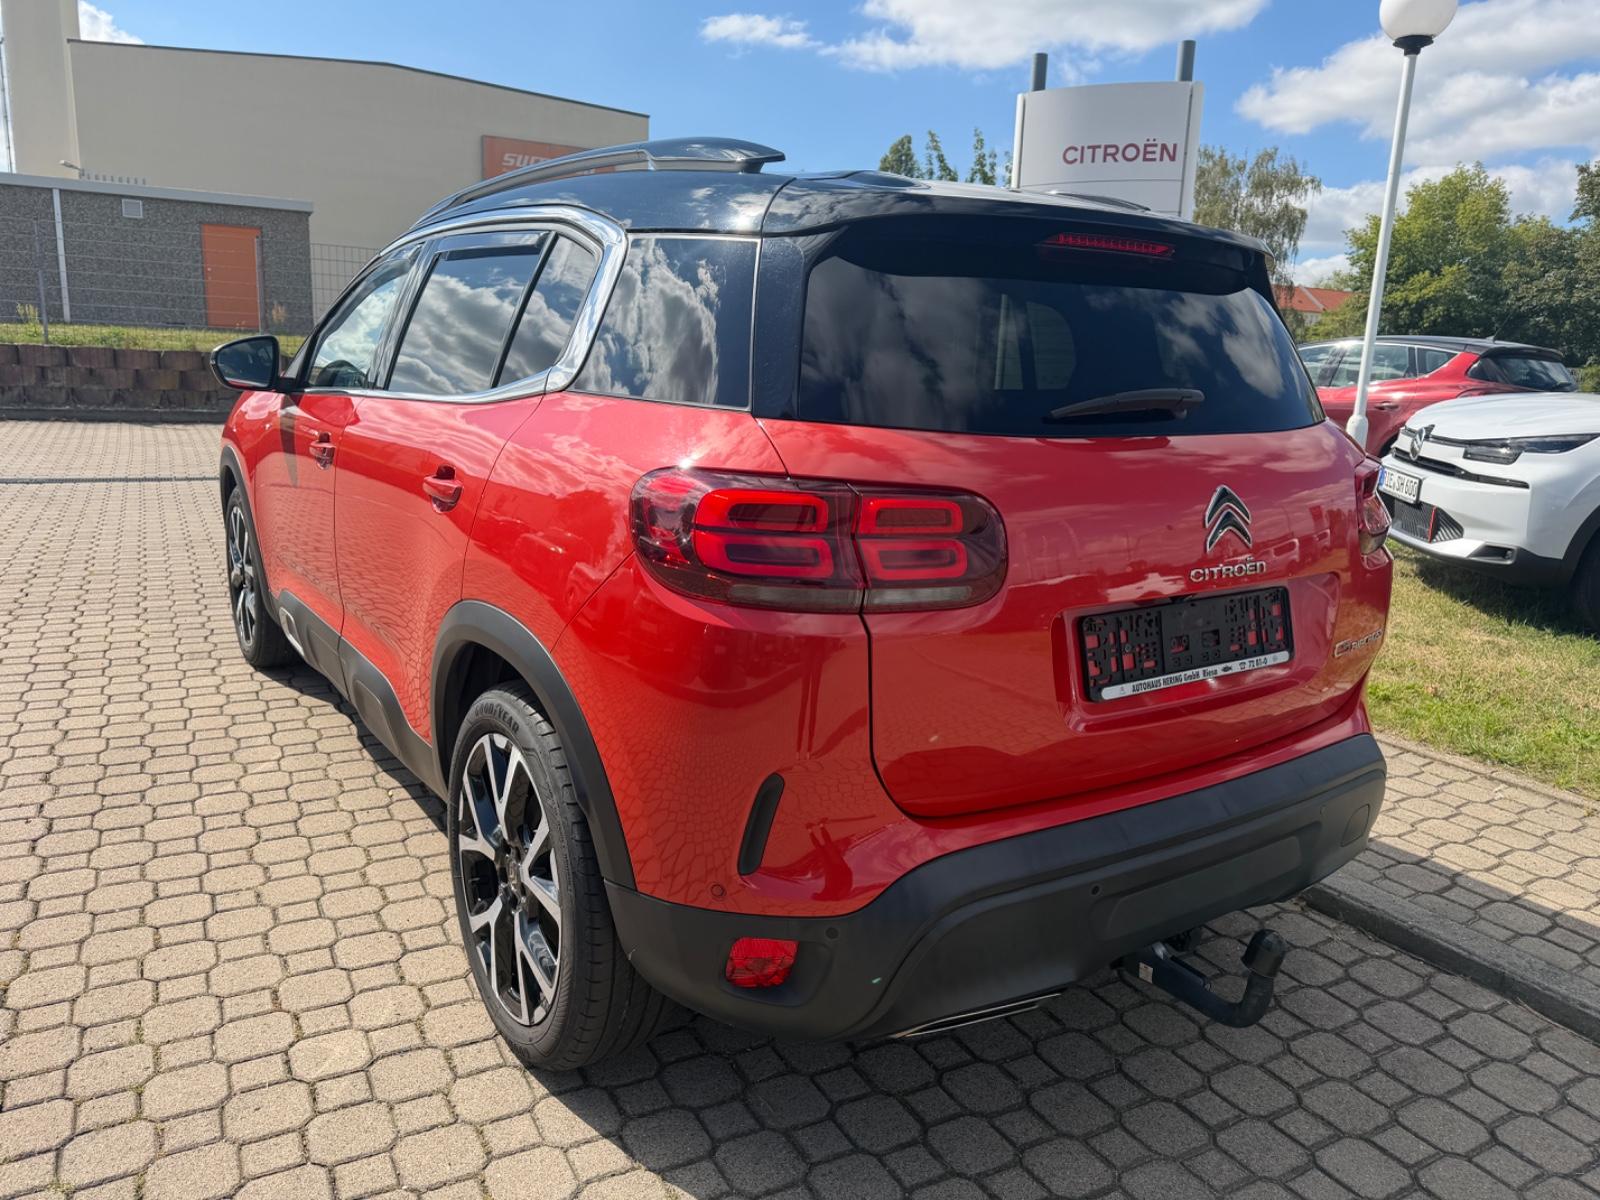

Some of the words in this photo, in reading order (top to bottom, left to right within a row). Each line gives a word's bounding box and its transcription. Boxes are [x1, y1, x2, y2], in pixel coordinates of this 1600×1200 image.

[1062, 138, 1178, 165] CITROËN
[1190, 556, 1267, 583] CITROËN
[1132, 677, 1162, 693] AUTOHAUS
[1162, 673, 1183, 686] HERING
